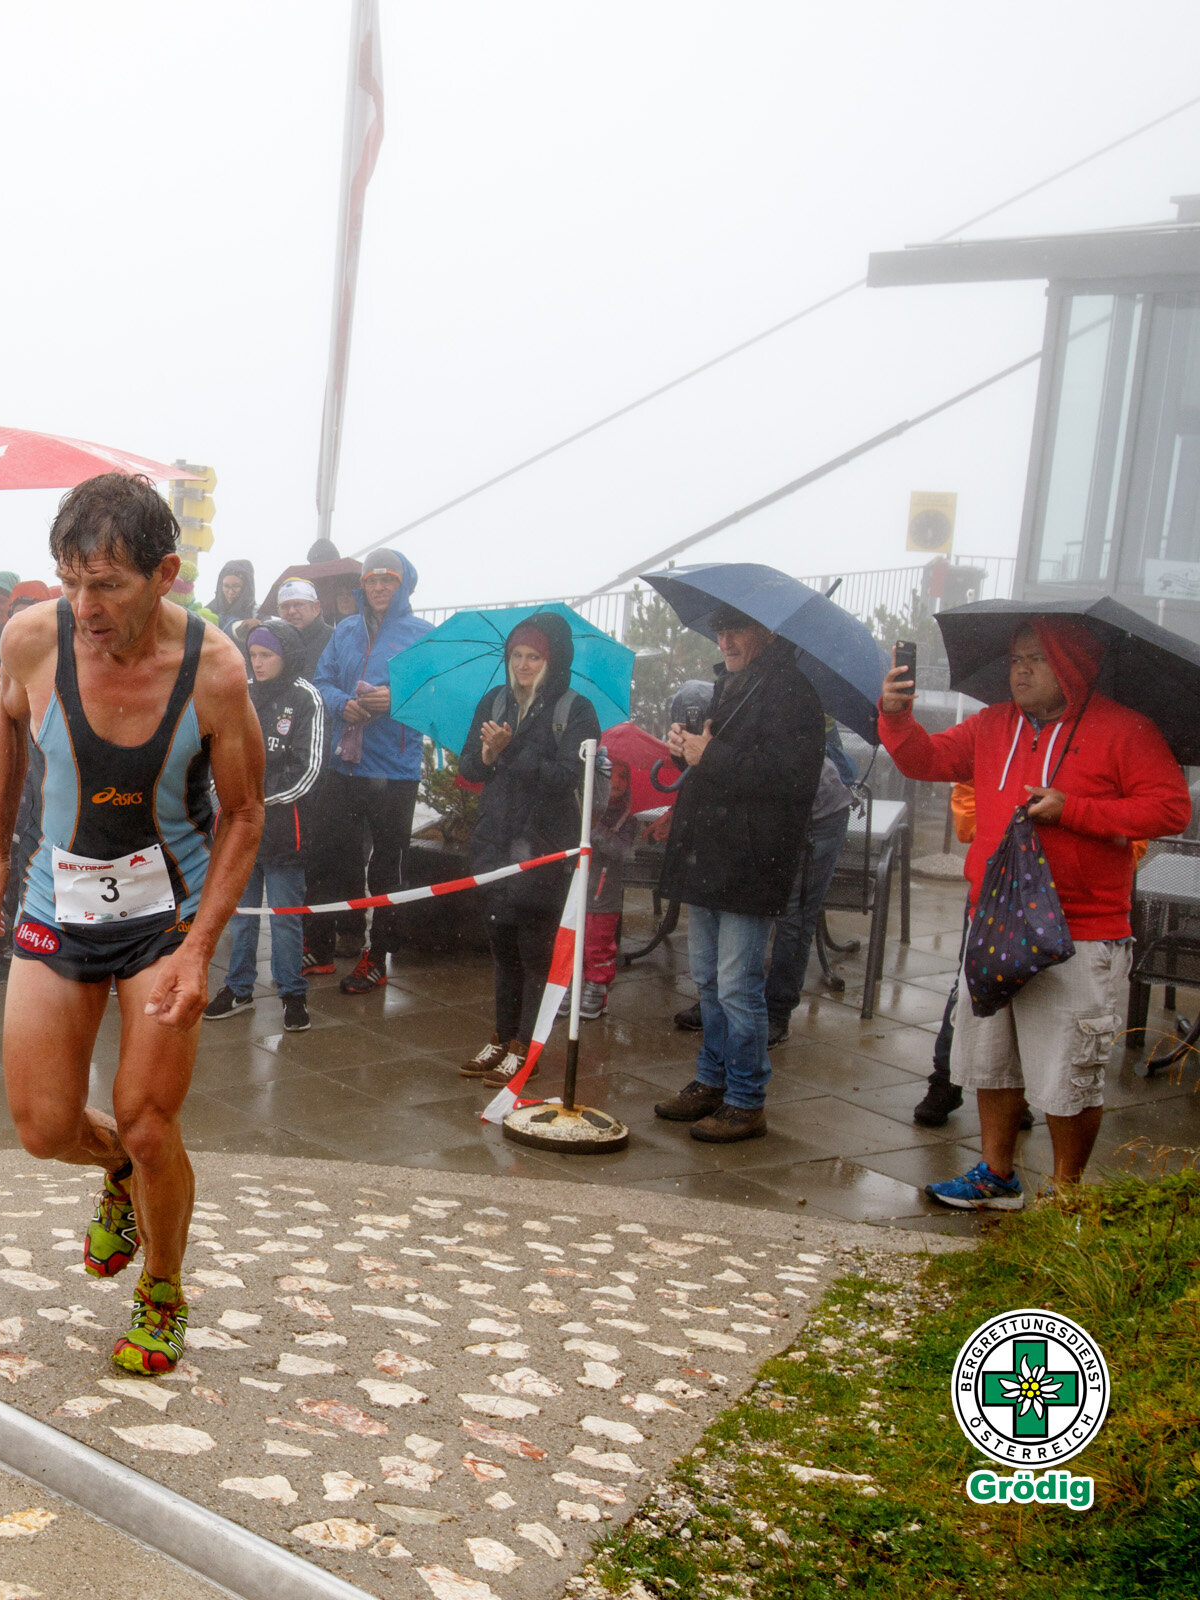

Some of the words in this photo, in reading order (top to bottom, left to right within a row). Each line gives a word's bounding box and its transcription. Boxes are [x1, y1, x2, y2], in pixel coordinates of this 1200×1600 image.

[58, 862, 114, 871] BEYRINGER
[99, 876, 120, 903] 3
[17, 923, 56, 950] Hervis
